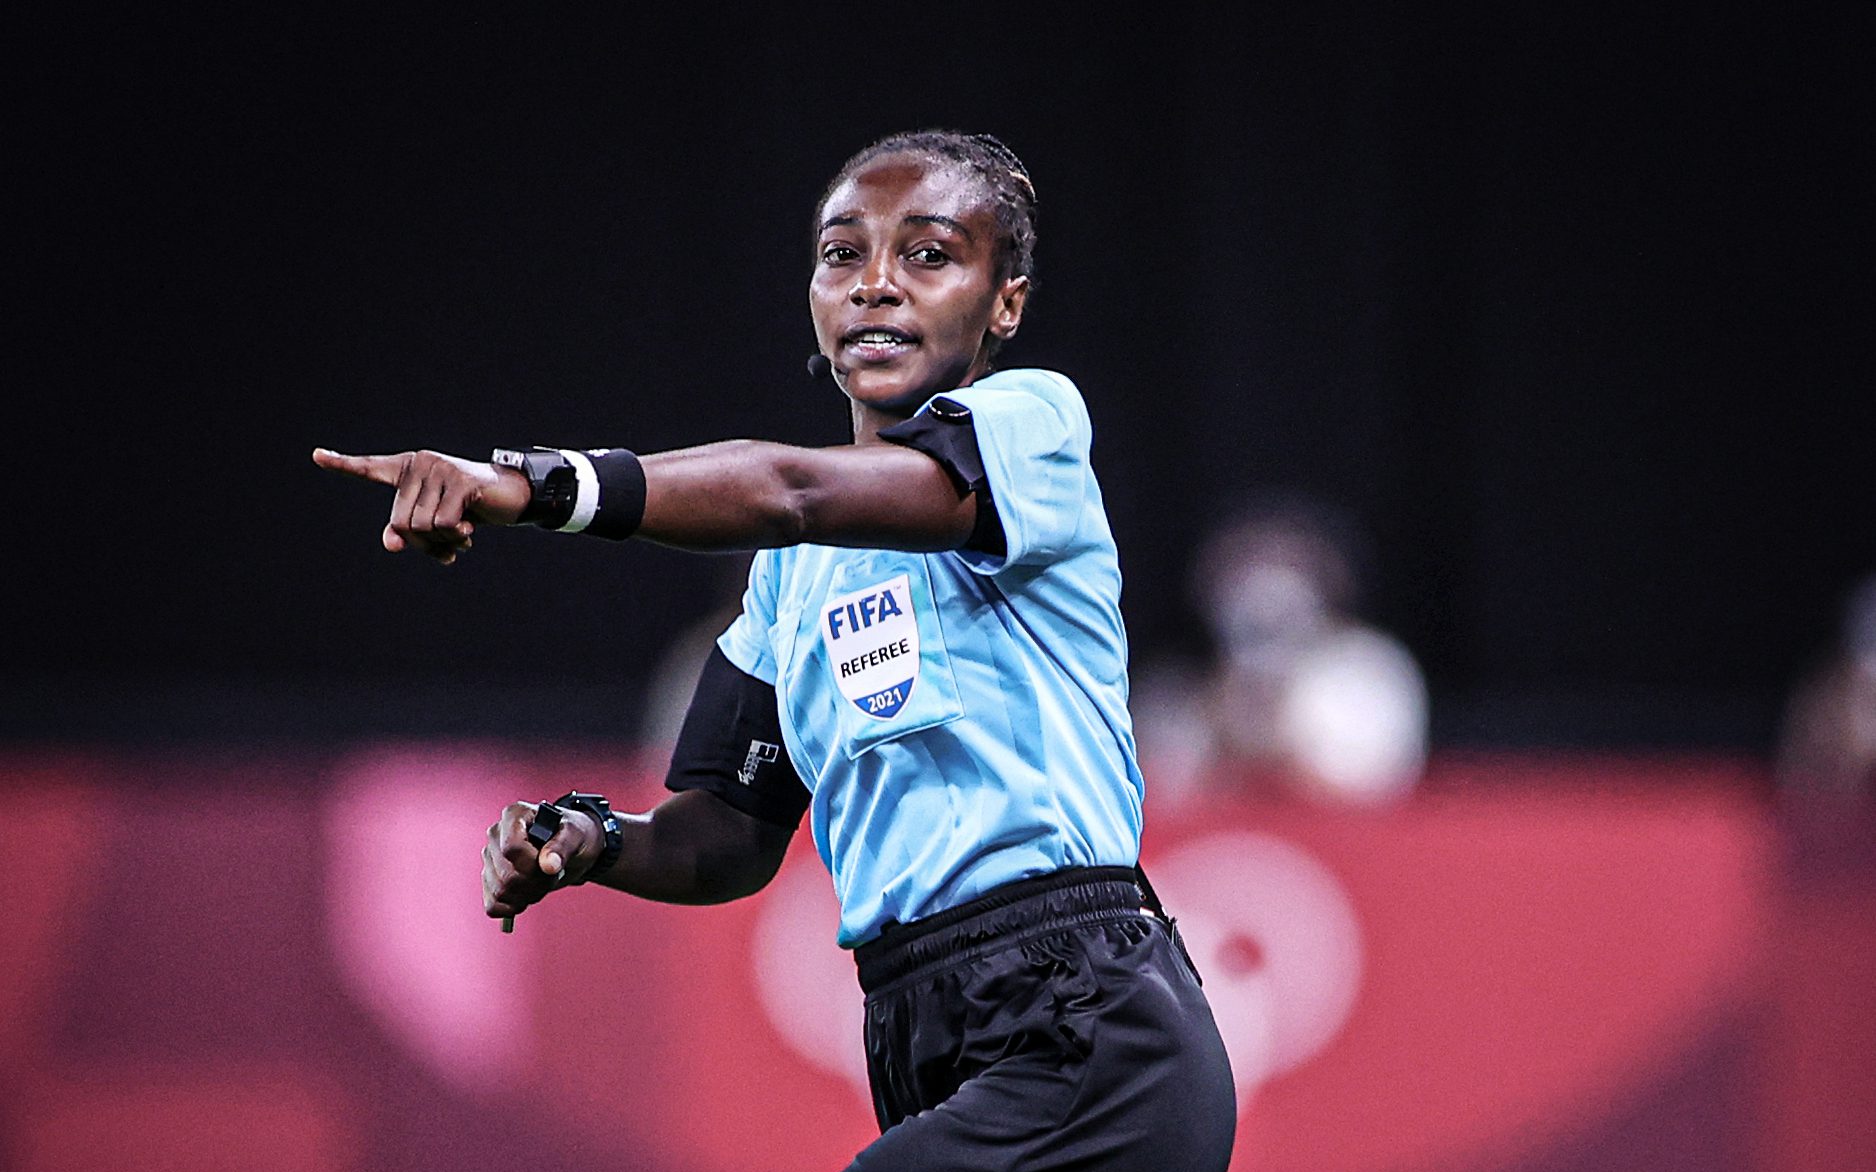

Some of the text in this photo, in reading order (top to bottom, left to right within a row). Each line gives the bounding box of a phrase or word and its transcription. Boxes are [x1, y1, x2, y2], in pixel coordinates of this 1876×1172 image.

[828, 590, 902, 640] FIFA
[840, 638, 910, 678] REFEREE
[867, 687, 903, 713] 2021
